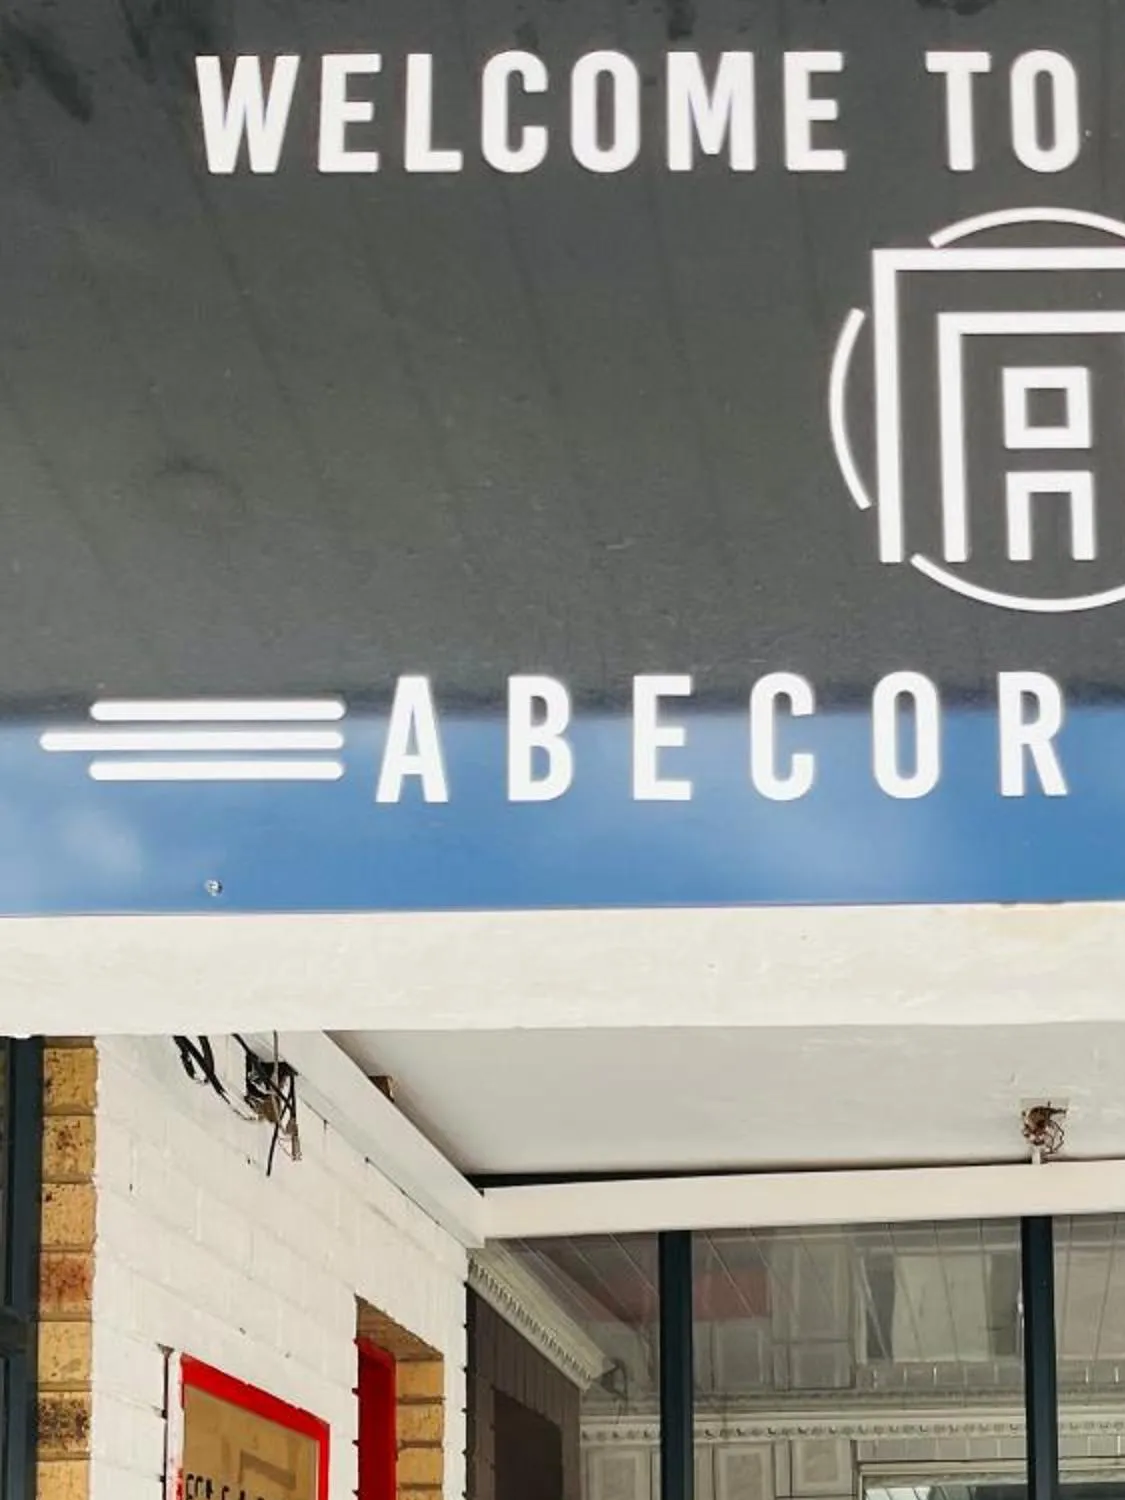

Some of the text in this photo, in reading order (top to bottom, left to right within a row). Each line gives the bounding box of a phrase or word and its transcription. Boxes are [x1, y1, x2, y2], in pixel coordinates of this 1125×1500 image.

[194, 50, 848, 174] WELCOME
[925, 49, 1080, 173] TO
[375, 670, 1069, 804] ABECOR
